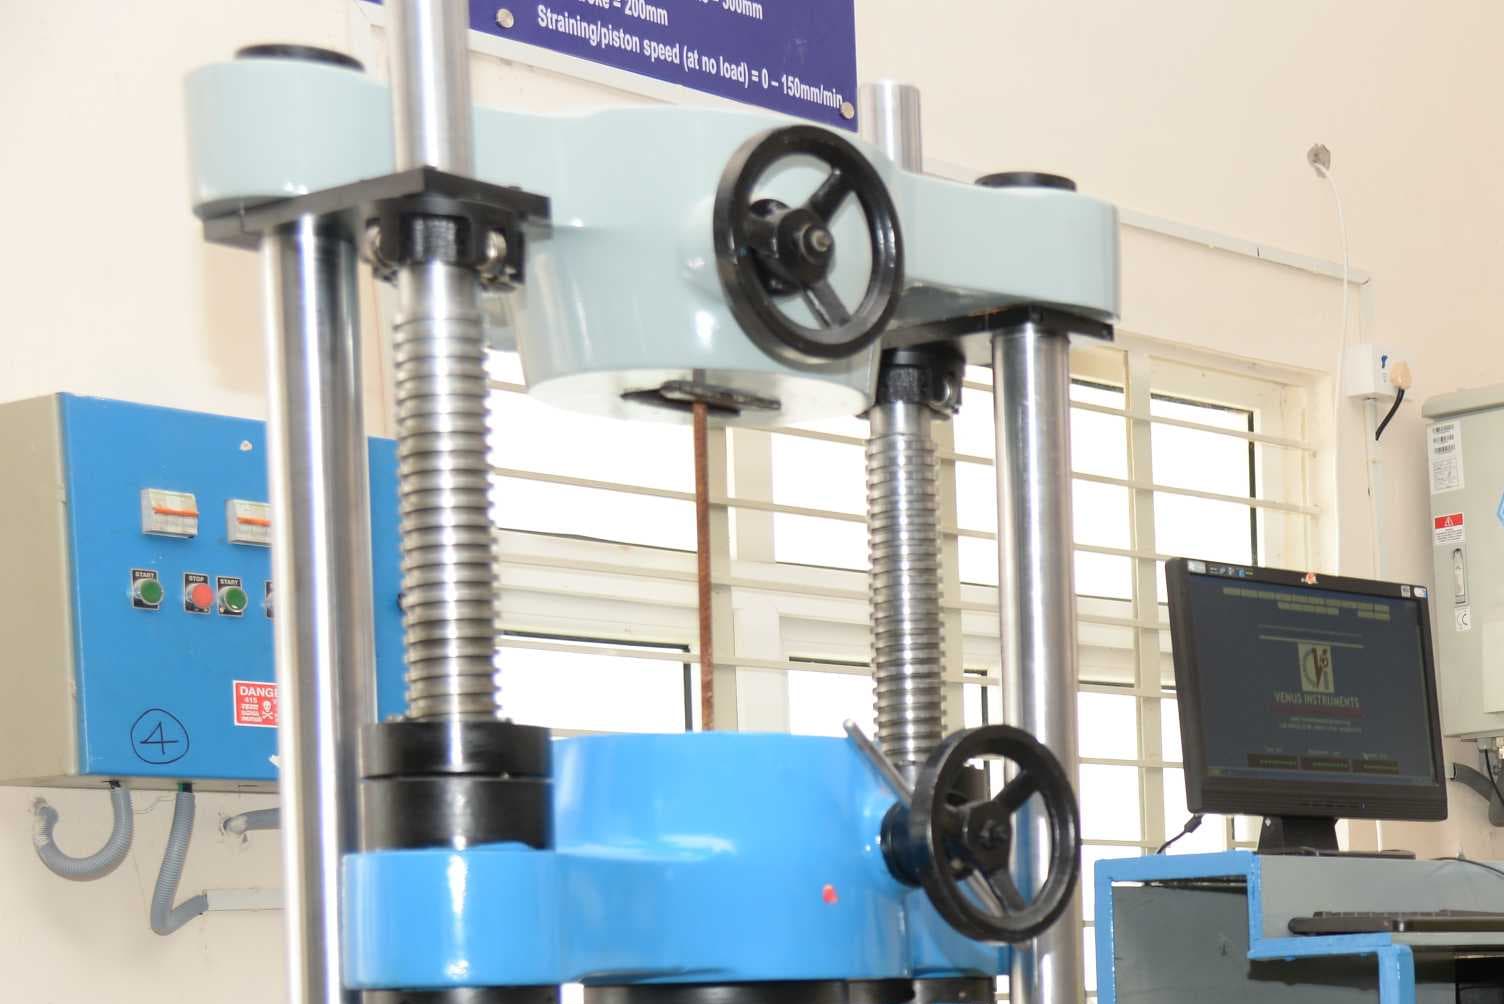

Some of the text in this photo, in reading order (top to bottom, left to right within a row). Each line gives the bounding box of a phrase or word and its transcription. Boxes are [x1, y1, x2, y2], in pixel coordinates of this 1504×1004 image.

[624, 0, 669, 26] 200mm
[537, 5, 641, 53] Straining/piston
[643, 37, 680, 66] speed
[683, 48, 699, 72] (at
[702, 54, 717, 75] no
[719, 58, 749, 90] load)
[752, 69, 759, 82] =
[761, 71, 769, 90] 0
[781, 75, 843, 110] 150mm/min
[135, 571, 155, 579] START
[189, 575, 205, 583] STOP
[240, 686, 279, 698] DANGE
[140, 720, 179, 755] 4
